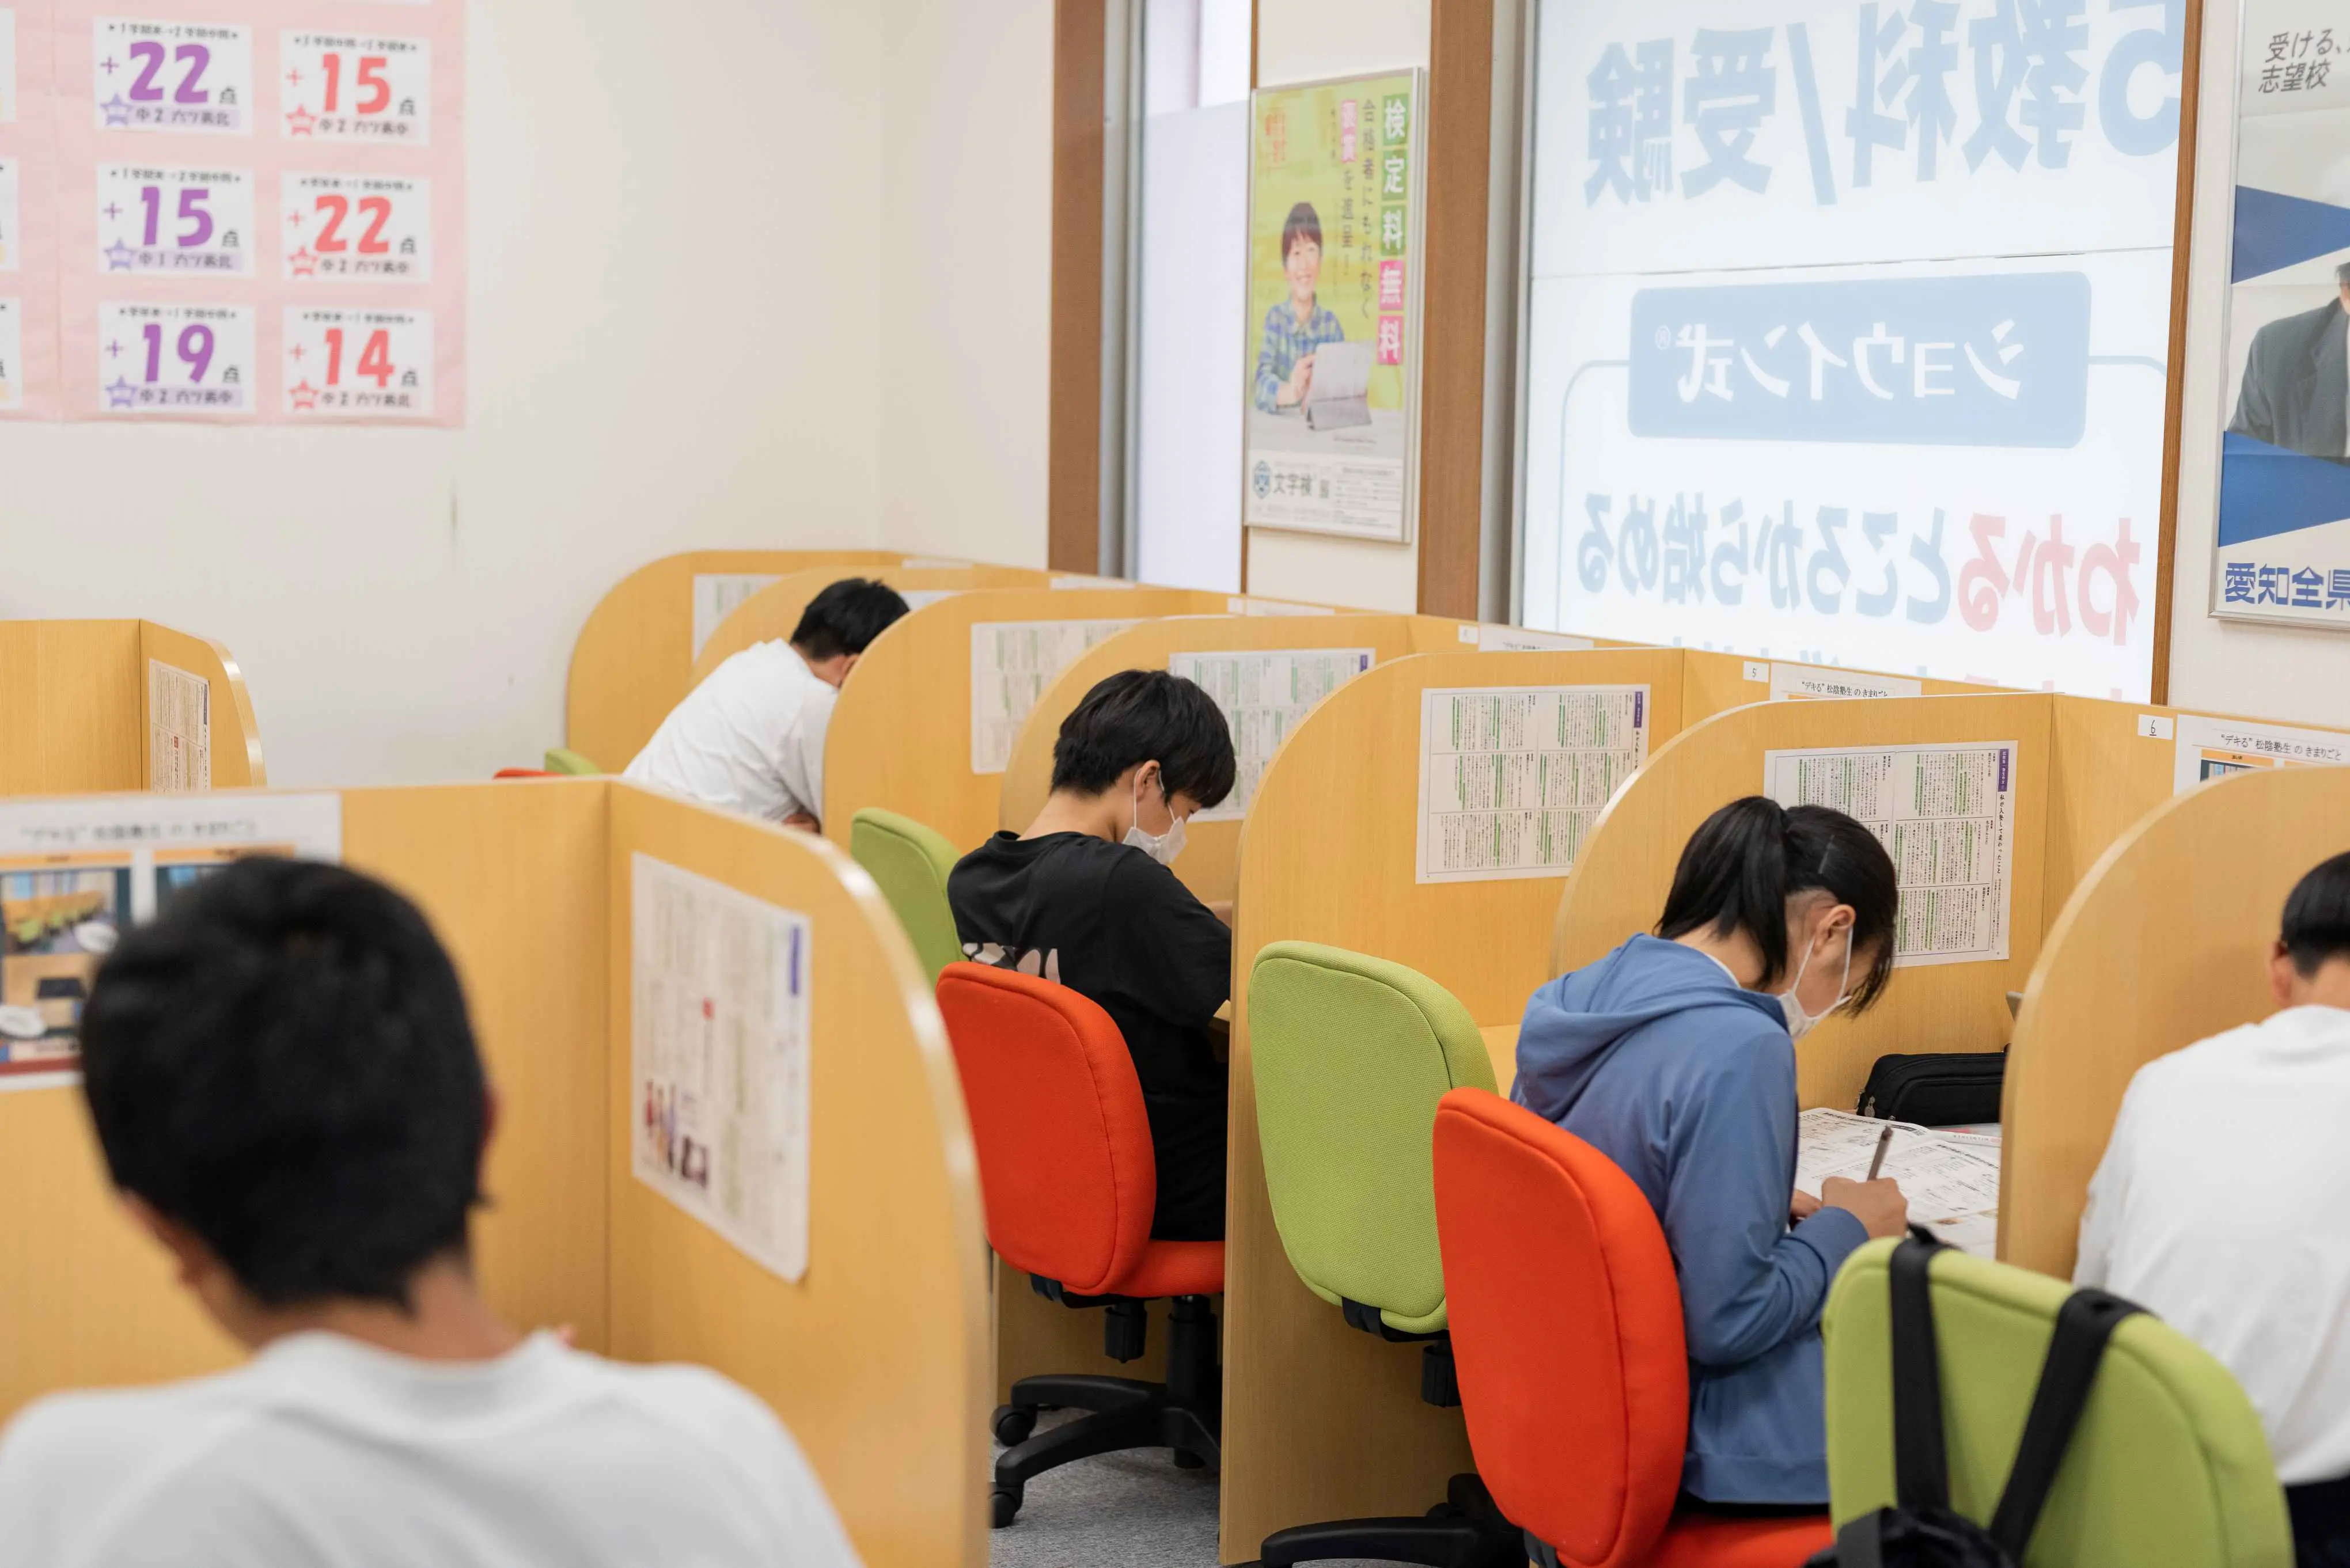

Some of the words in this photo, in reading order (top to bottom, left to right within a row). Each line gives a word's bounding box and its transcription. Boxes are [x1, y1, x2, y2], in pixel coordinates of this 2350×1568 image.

[2265, 28, 2350, 63] 受ける、
[100, 41, 237, 105] +22点
[285, 54, 416, 115] +15点
[2258, 58, 2332, 94] 志望校
[103, 187, 239, 247] +15点
[288, 195, 416, 255] +22点
[1379, 98, 1406, 360] 検定料無料
[105, 324, 240, 383] +19点
[290, 328, 418, 387] +14点
[2224, 562, 2350, 610] 愛知全県
[1752, 668, 1757, 678] 5
[1827, 684, 1852, 696] 松陰塾生
[2151, 719, 2156, 734] 6
[2256, 740, 2291, 754] 松陰塾生
[2295, 745, 2303, 754] の
[2306, 746, 2341, 761] きまりごと
